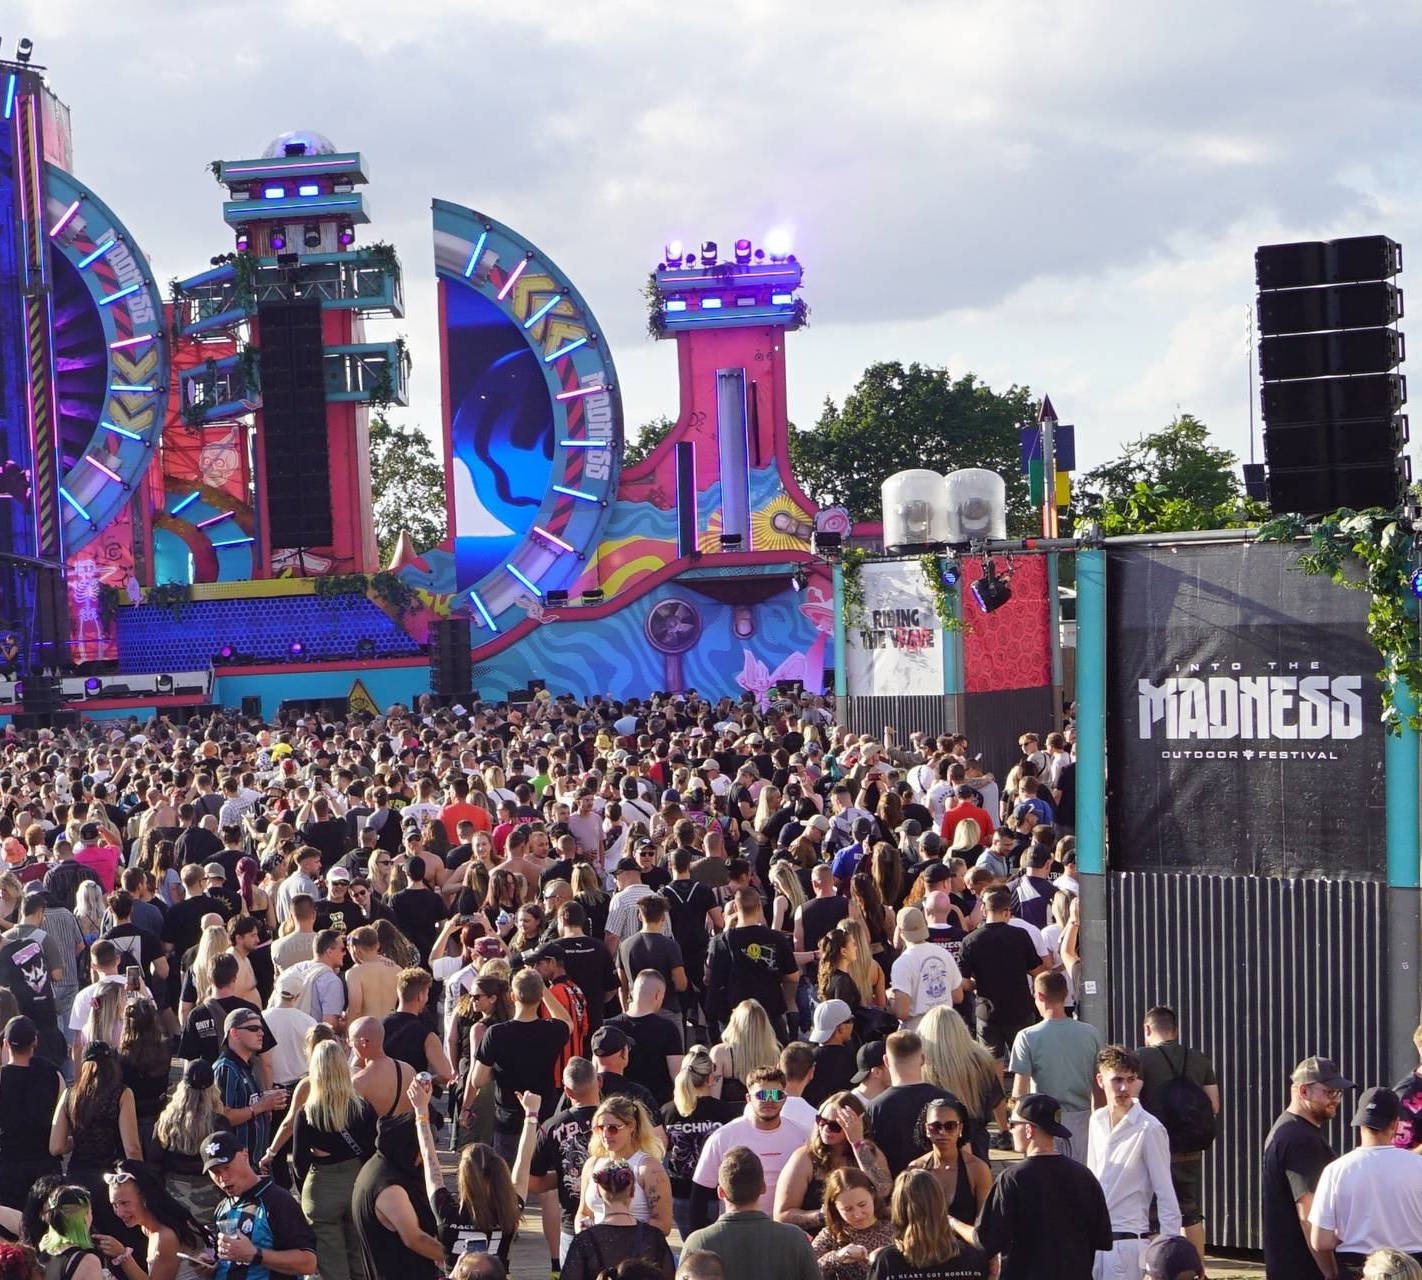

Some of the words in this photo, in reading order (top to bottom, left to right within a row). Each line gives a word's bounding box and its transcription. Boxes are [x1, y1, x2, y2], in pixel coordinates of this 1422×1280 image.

[95, 228, 156, 324] MADNSS
[581, 371, 613, 480] MADNSS
[873, 609, 920, 629] RIDING
[860, 630, 886, 649] THE
[890, 628, 934, 648] WAVE
[1176, 662, 1241, 671] INTO
[1268, 662, 1319, 670] THE
[1138, 675, 1363, 739] MADNESS
[1162, 751, 1238, 759] OUTDOOR
[1259, 751, 1338, 759] FESTIVAL
